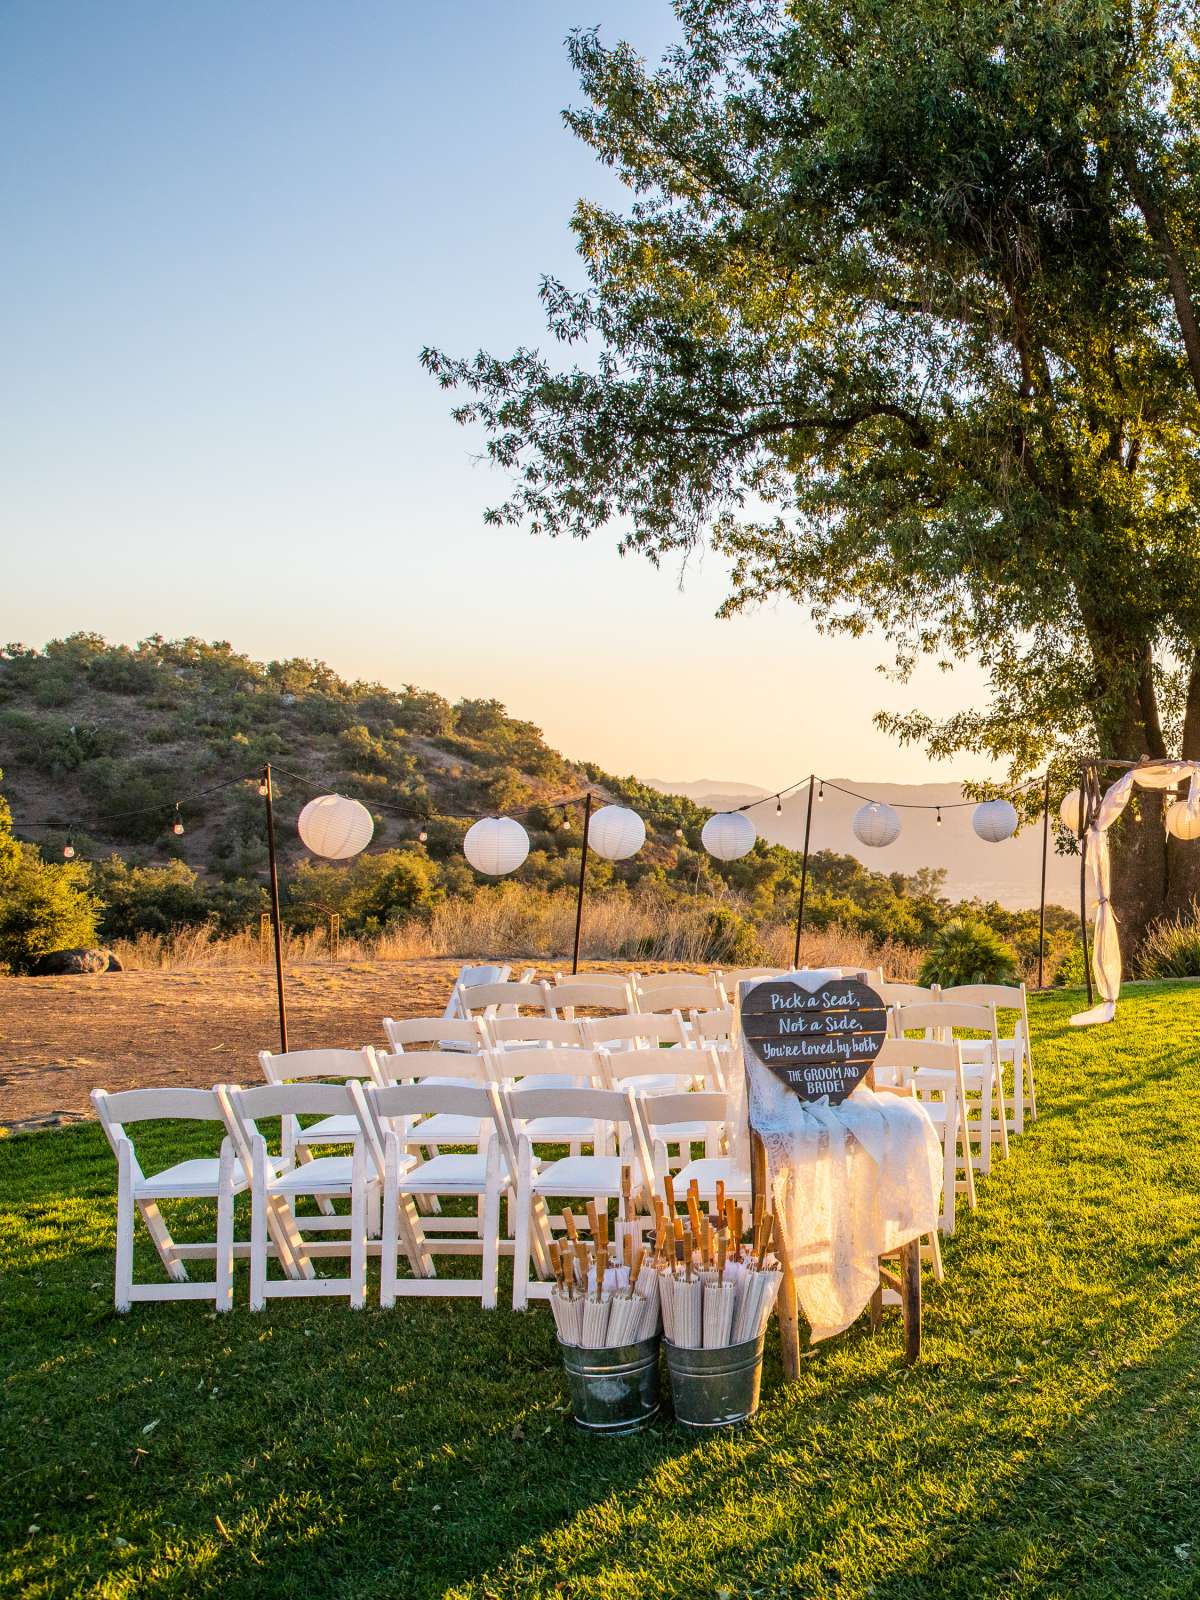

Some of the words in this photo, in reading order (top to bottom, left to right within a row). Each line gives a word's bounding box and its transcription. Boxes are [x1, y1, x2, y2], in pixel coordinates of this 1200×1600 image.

[771, 993, 805, 1009] Pick
[807, 997, 820, 1006] a
[823, 990, 861, 1008] Seat,
[779, 1017, 808, 1034] Not
[810, 1021, 823, 1030] a
[826, 1016, 863, 1032] Side,
[801, 1041, 836, 1055] loved
[836, 1040, 851, 1058] by
[851, 1037, 879, 1052] both
[788, 1070, 803, 1082] THE
[804, 1066, 843, 1081] GROOM
[844, 1066, 859, 1078] AND
[807, 1080, 845, 1094] BRIDE!
